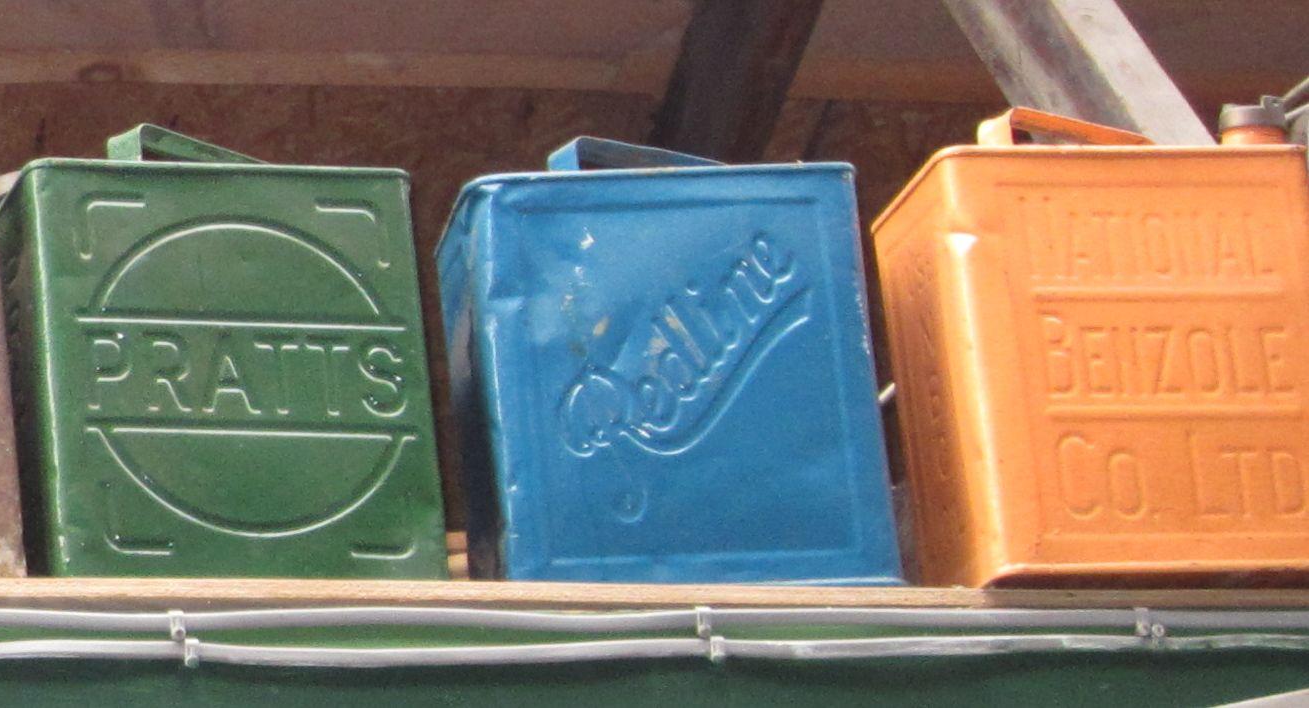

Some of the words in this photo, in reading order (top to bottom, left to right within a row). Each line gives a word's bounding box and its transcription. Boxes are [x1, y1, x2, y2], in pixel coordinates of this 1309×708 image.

[1017, 196, 1277, 281] NATIONAL
[84, 331, 408, 417] PRATTS
[1036, 309, 1296, 399] BENZOLE
